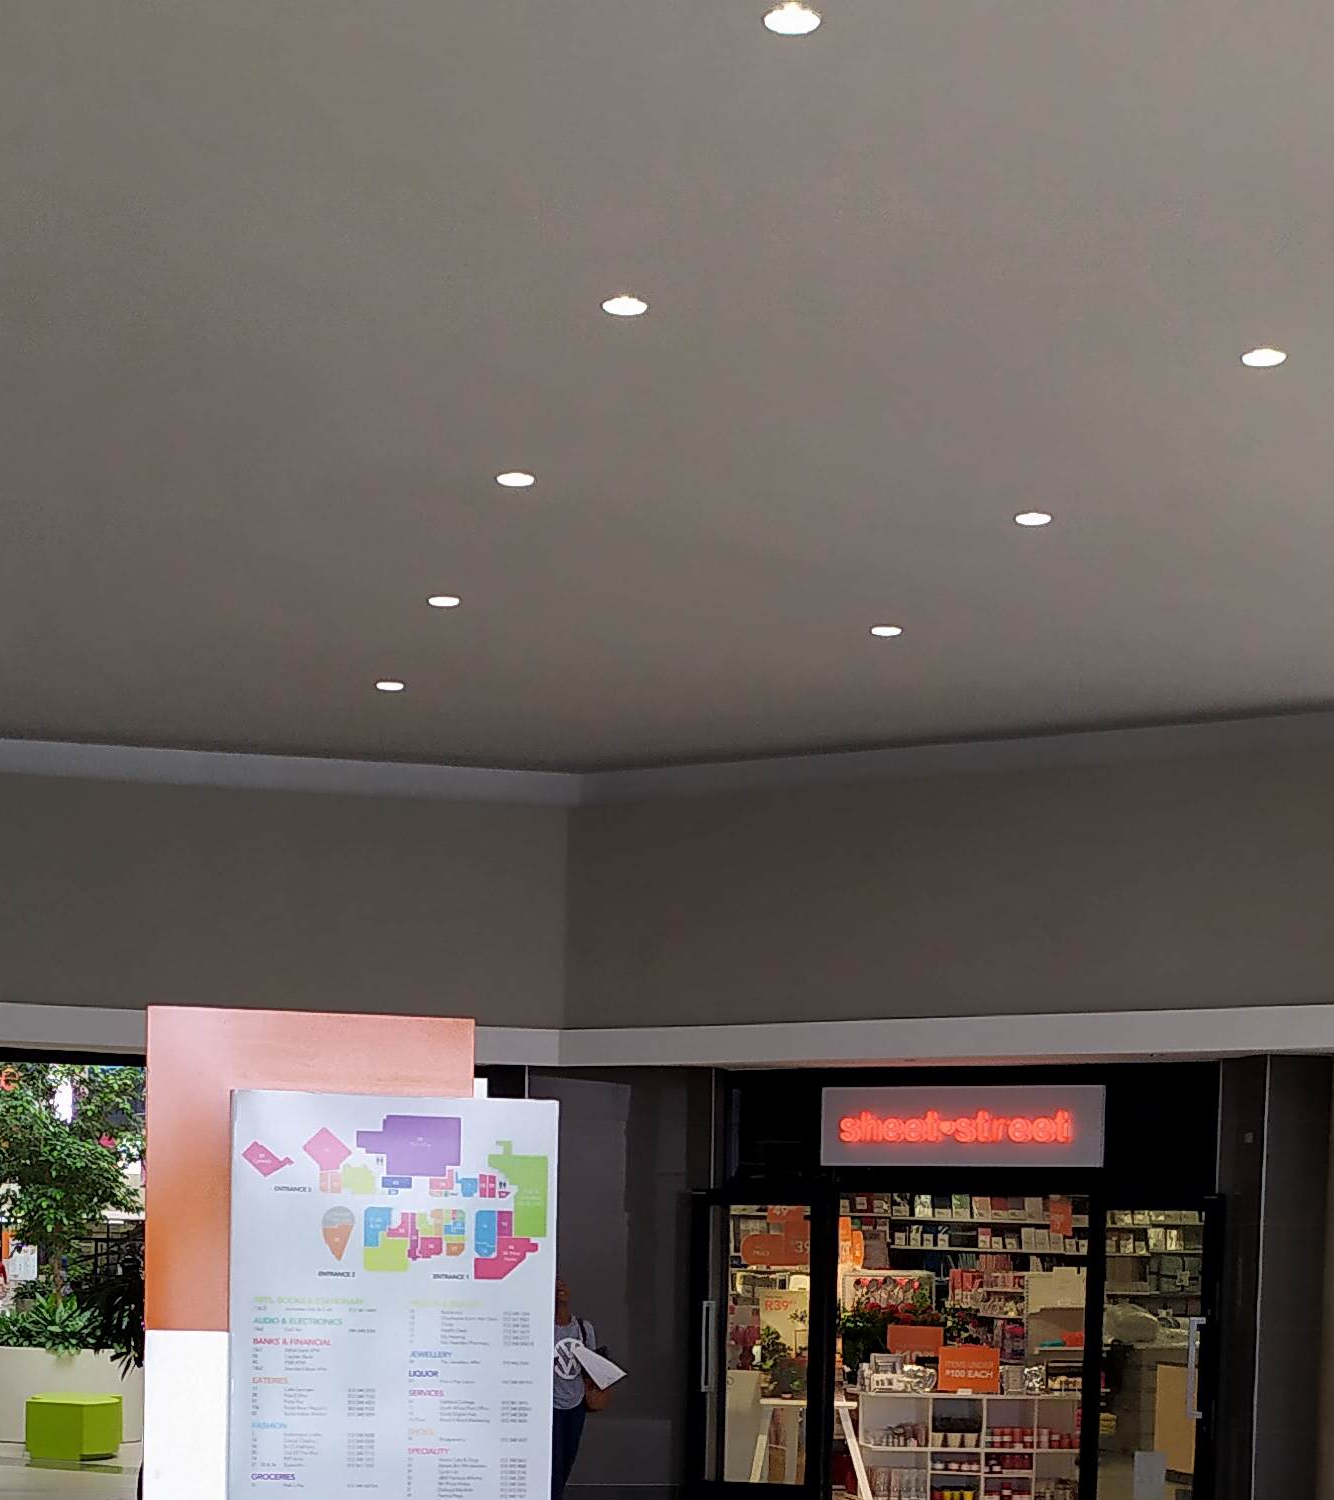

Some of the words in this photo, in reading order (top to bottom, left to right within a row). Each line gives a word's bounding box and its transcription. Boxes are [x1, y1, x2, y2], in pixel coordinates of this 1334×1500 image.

[839, 1109, 939, 1143] sheet
[954, 1109, 1074, 1143] street
[253, 1317, 279, 1325] AUDIO
[253, 1338, 281, 1346] BANKS
[289, 1338, 331, 1346] FINANCIAL
[408, 1369, 439, 1377] LIQUOR
[968, 1370, 994, 1378] EACH
[409, 1389, 444, 1397] SERVICES
[251, 1473, 295, 1481] GROCERIES
